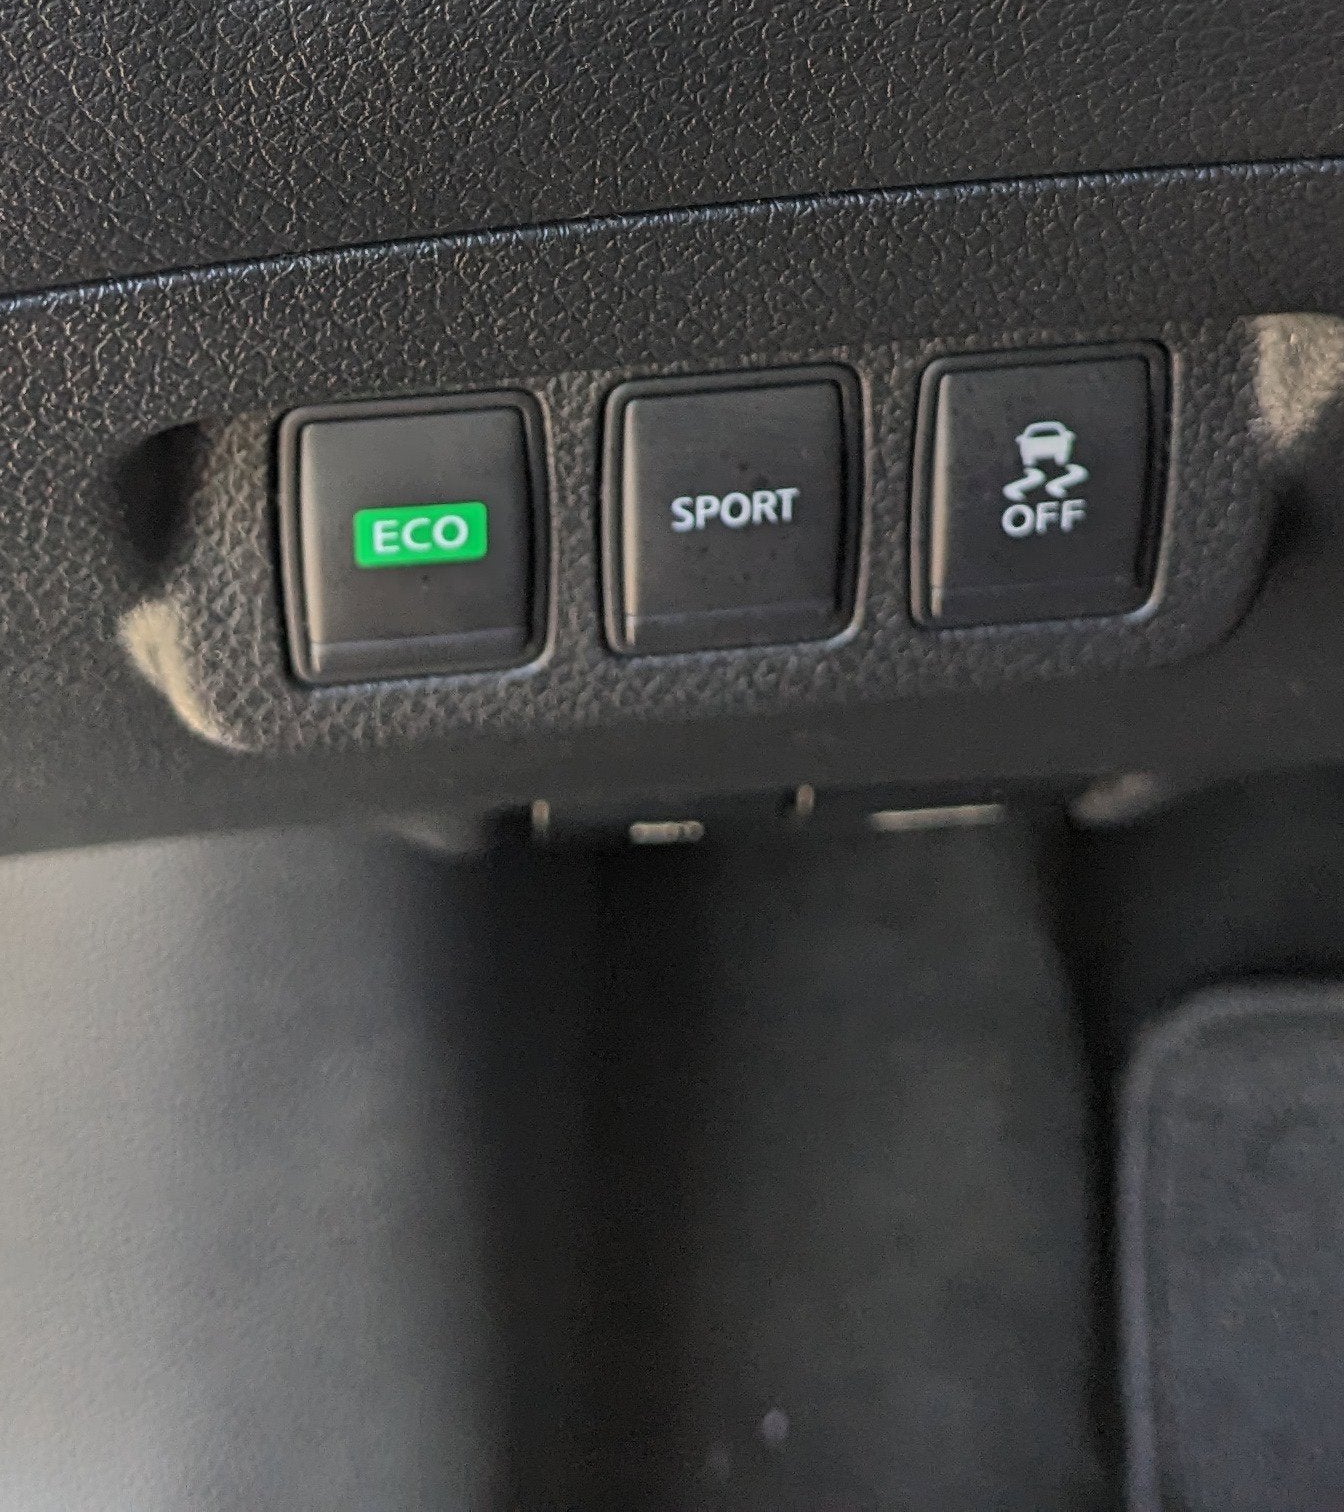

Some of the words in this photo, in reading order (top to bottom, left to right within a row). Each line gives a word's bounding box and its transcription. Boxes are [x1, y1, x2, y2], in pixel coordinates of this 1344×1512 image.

[670, 487, 801, 533] SPORT
[1001, 498, 1088, 538] OFF
[372, 514, 469, 555] ECO
